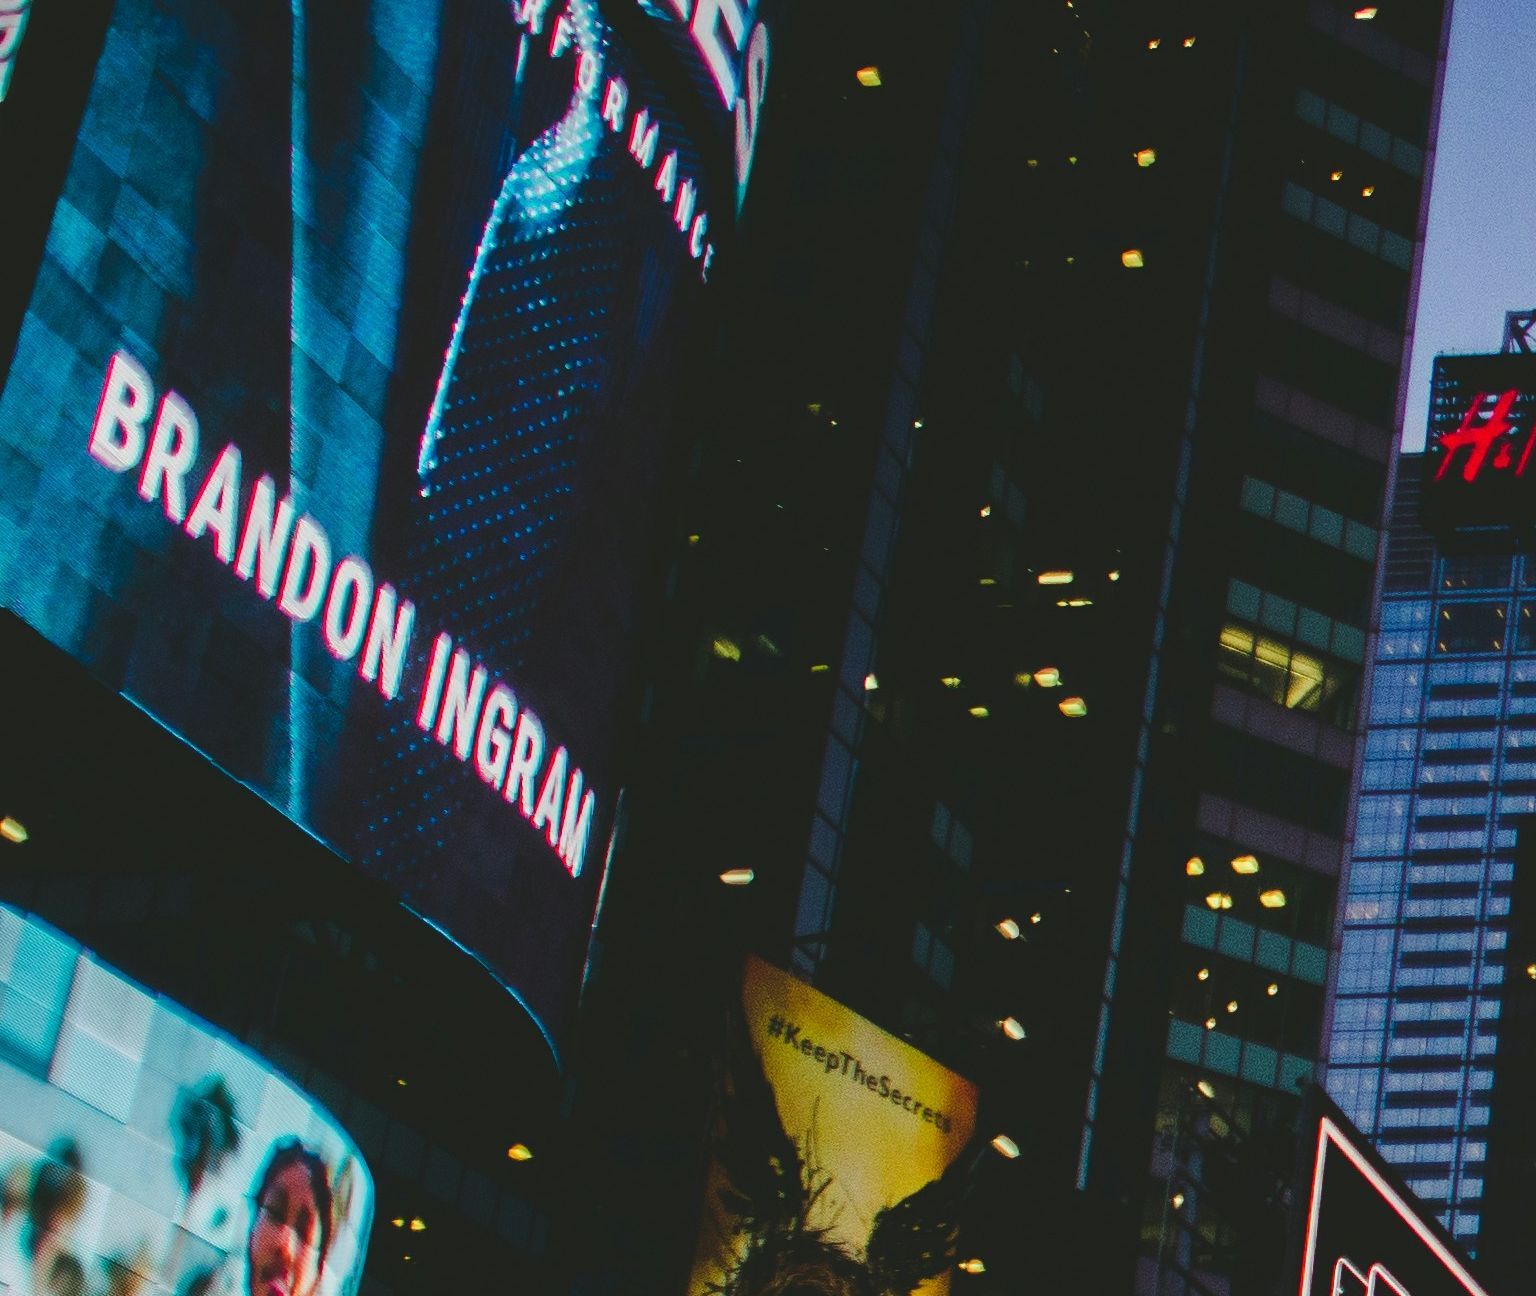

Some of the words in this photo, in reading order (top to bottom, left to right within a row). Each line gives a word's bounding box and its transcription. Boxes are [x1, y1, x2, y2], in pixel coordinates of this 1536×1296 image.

[88, 349, 416, 701] BRANDON
[416, 632, 596, 880] INGRAM
[765, 1013, 953, 1134] #KeepTheSecrets
